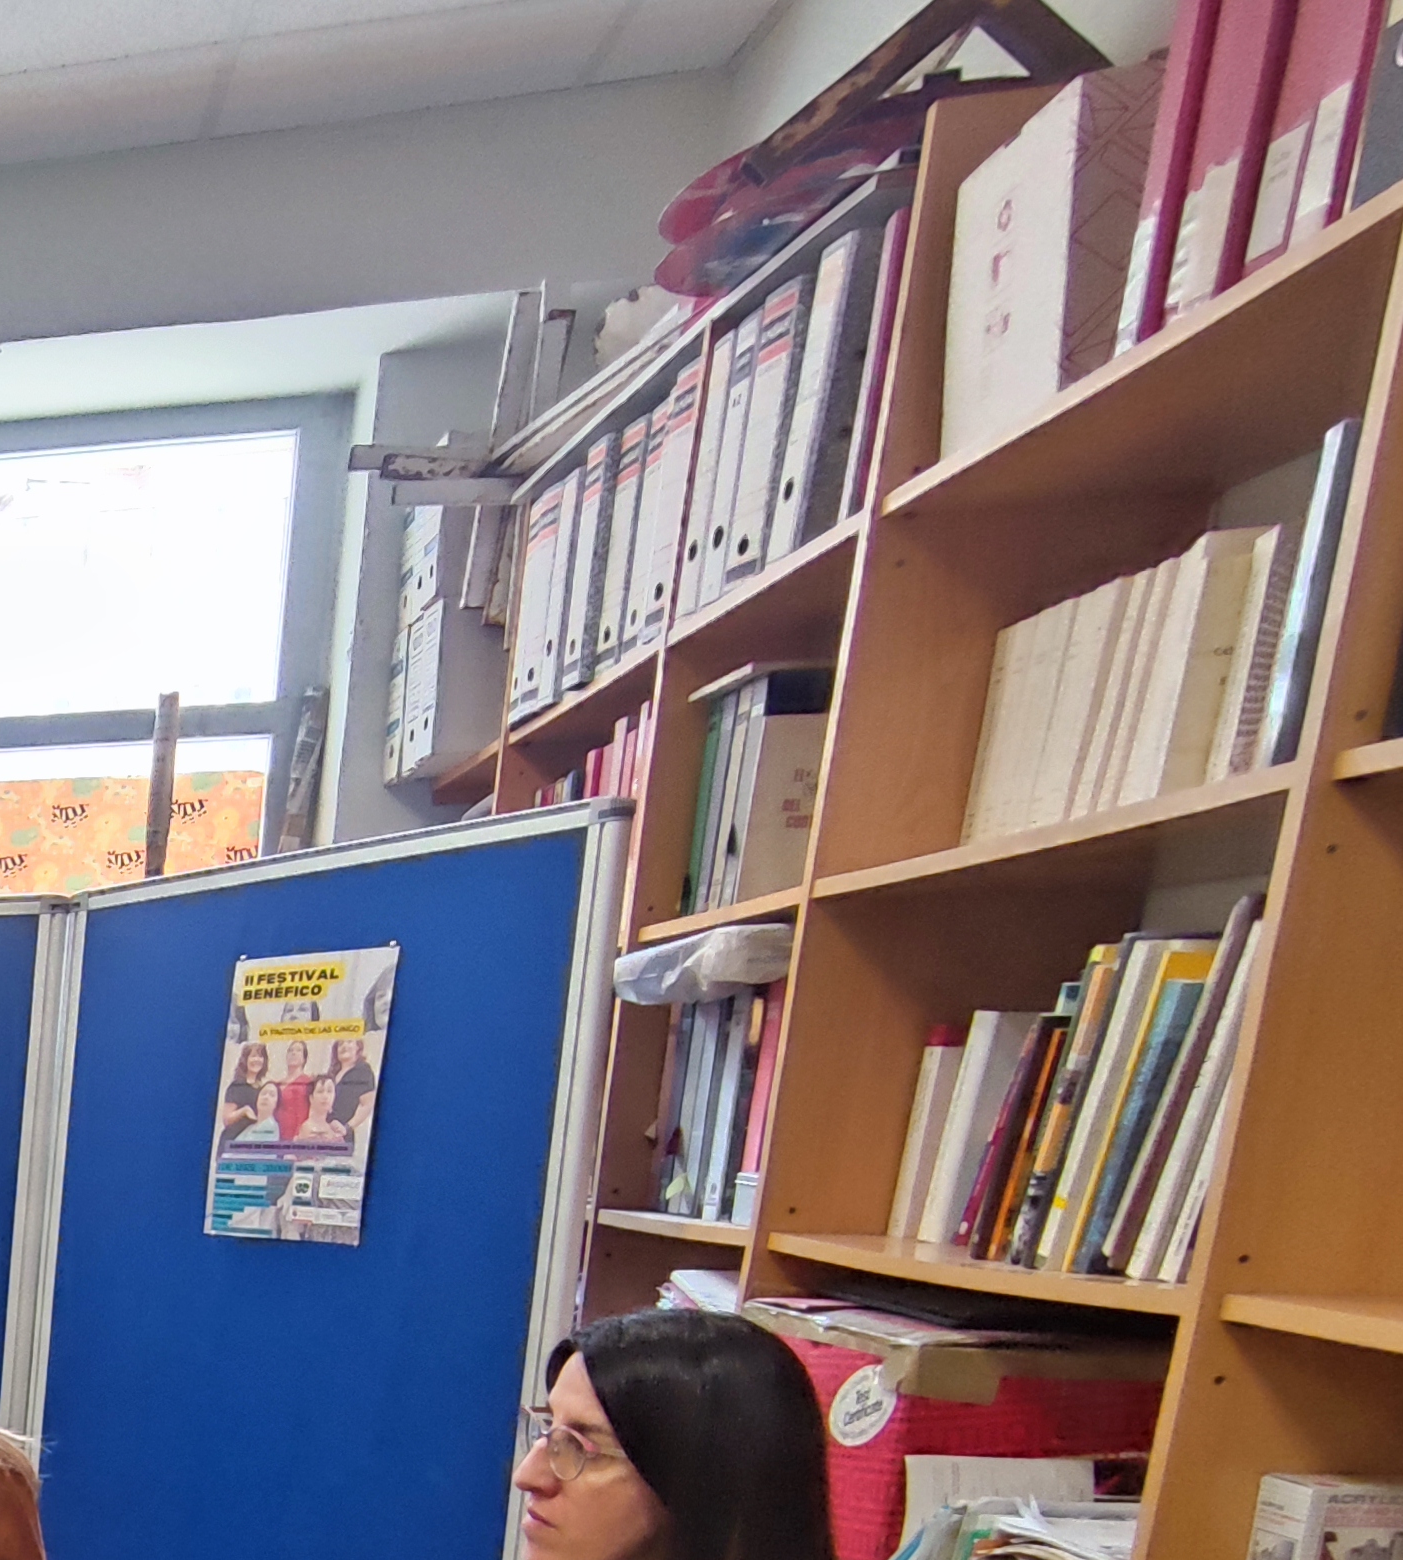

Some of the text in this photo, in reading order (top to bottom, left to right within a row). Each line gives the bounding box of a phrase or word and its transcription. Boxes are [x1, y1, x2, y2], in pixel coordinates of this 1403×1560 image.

[244, 968, 339, 986] II FESTIVAL
[242, 983, 322, 1001] BENÉFICO
